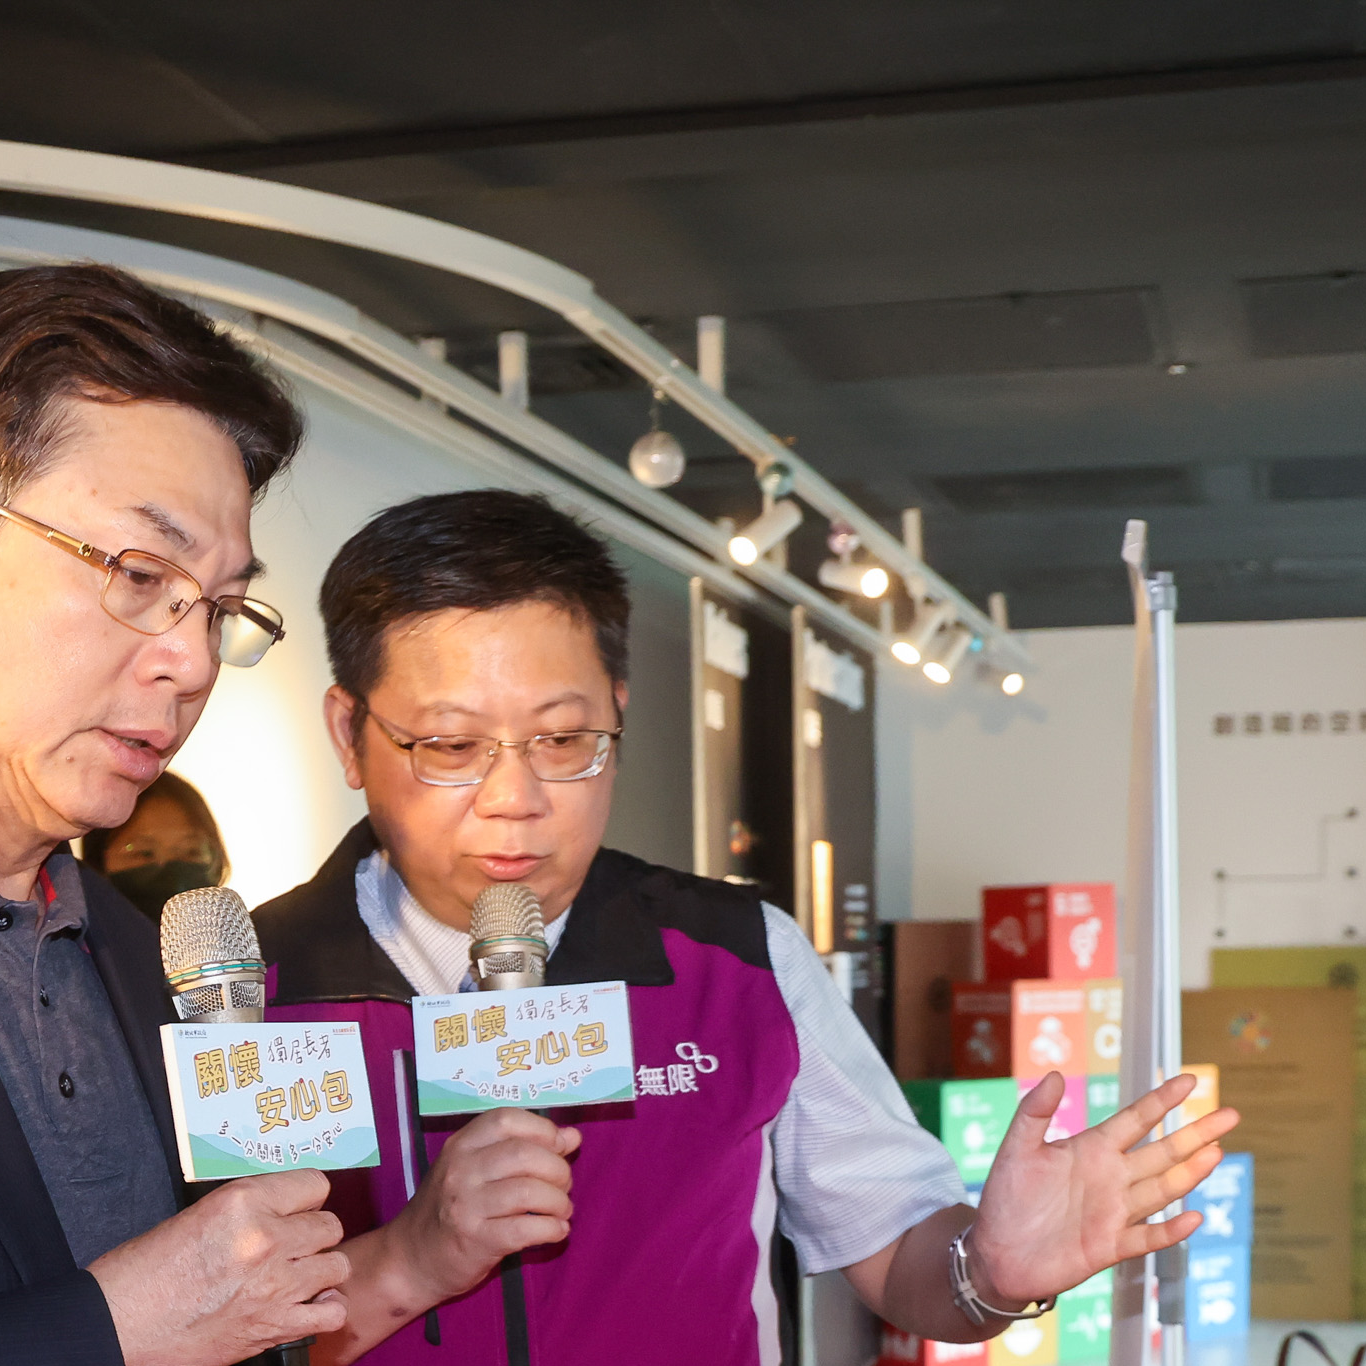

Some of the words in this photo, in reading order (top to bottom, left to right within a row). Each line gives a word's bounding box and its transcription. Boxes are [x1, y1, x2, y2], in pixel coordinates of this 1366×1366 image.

[434, 1004, 508, 1053] 關懷
[515, 991, 590, 1021] 獨居長者
[194, 1041, 264, 1099] 關懷
[267, 1030, 332, 1065] 獨居長者
[497, 1021, 609, 1077] 安心包
[255, 1070, 353, 1134] 安心包
[452, 1068, 521, 1100] 多一分關懷
[528, 1063, 593, 1098] 多一分安心
[633, 1063, 699, 1097] 無限
[218, 1120, 285, 1165] 多一分關懷
[288, 1122, 343, 1162] 多一分安心
